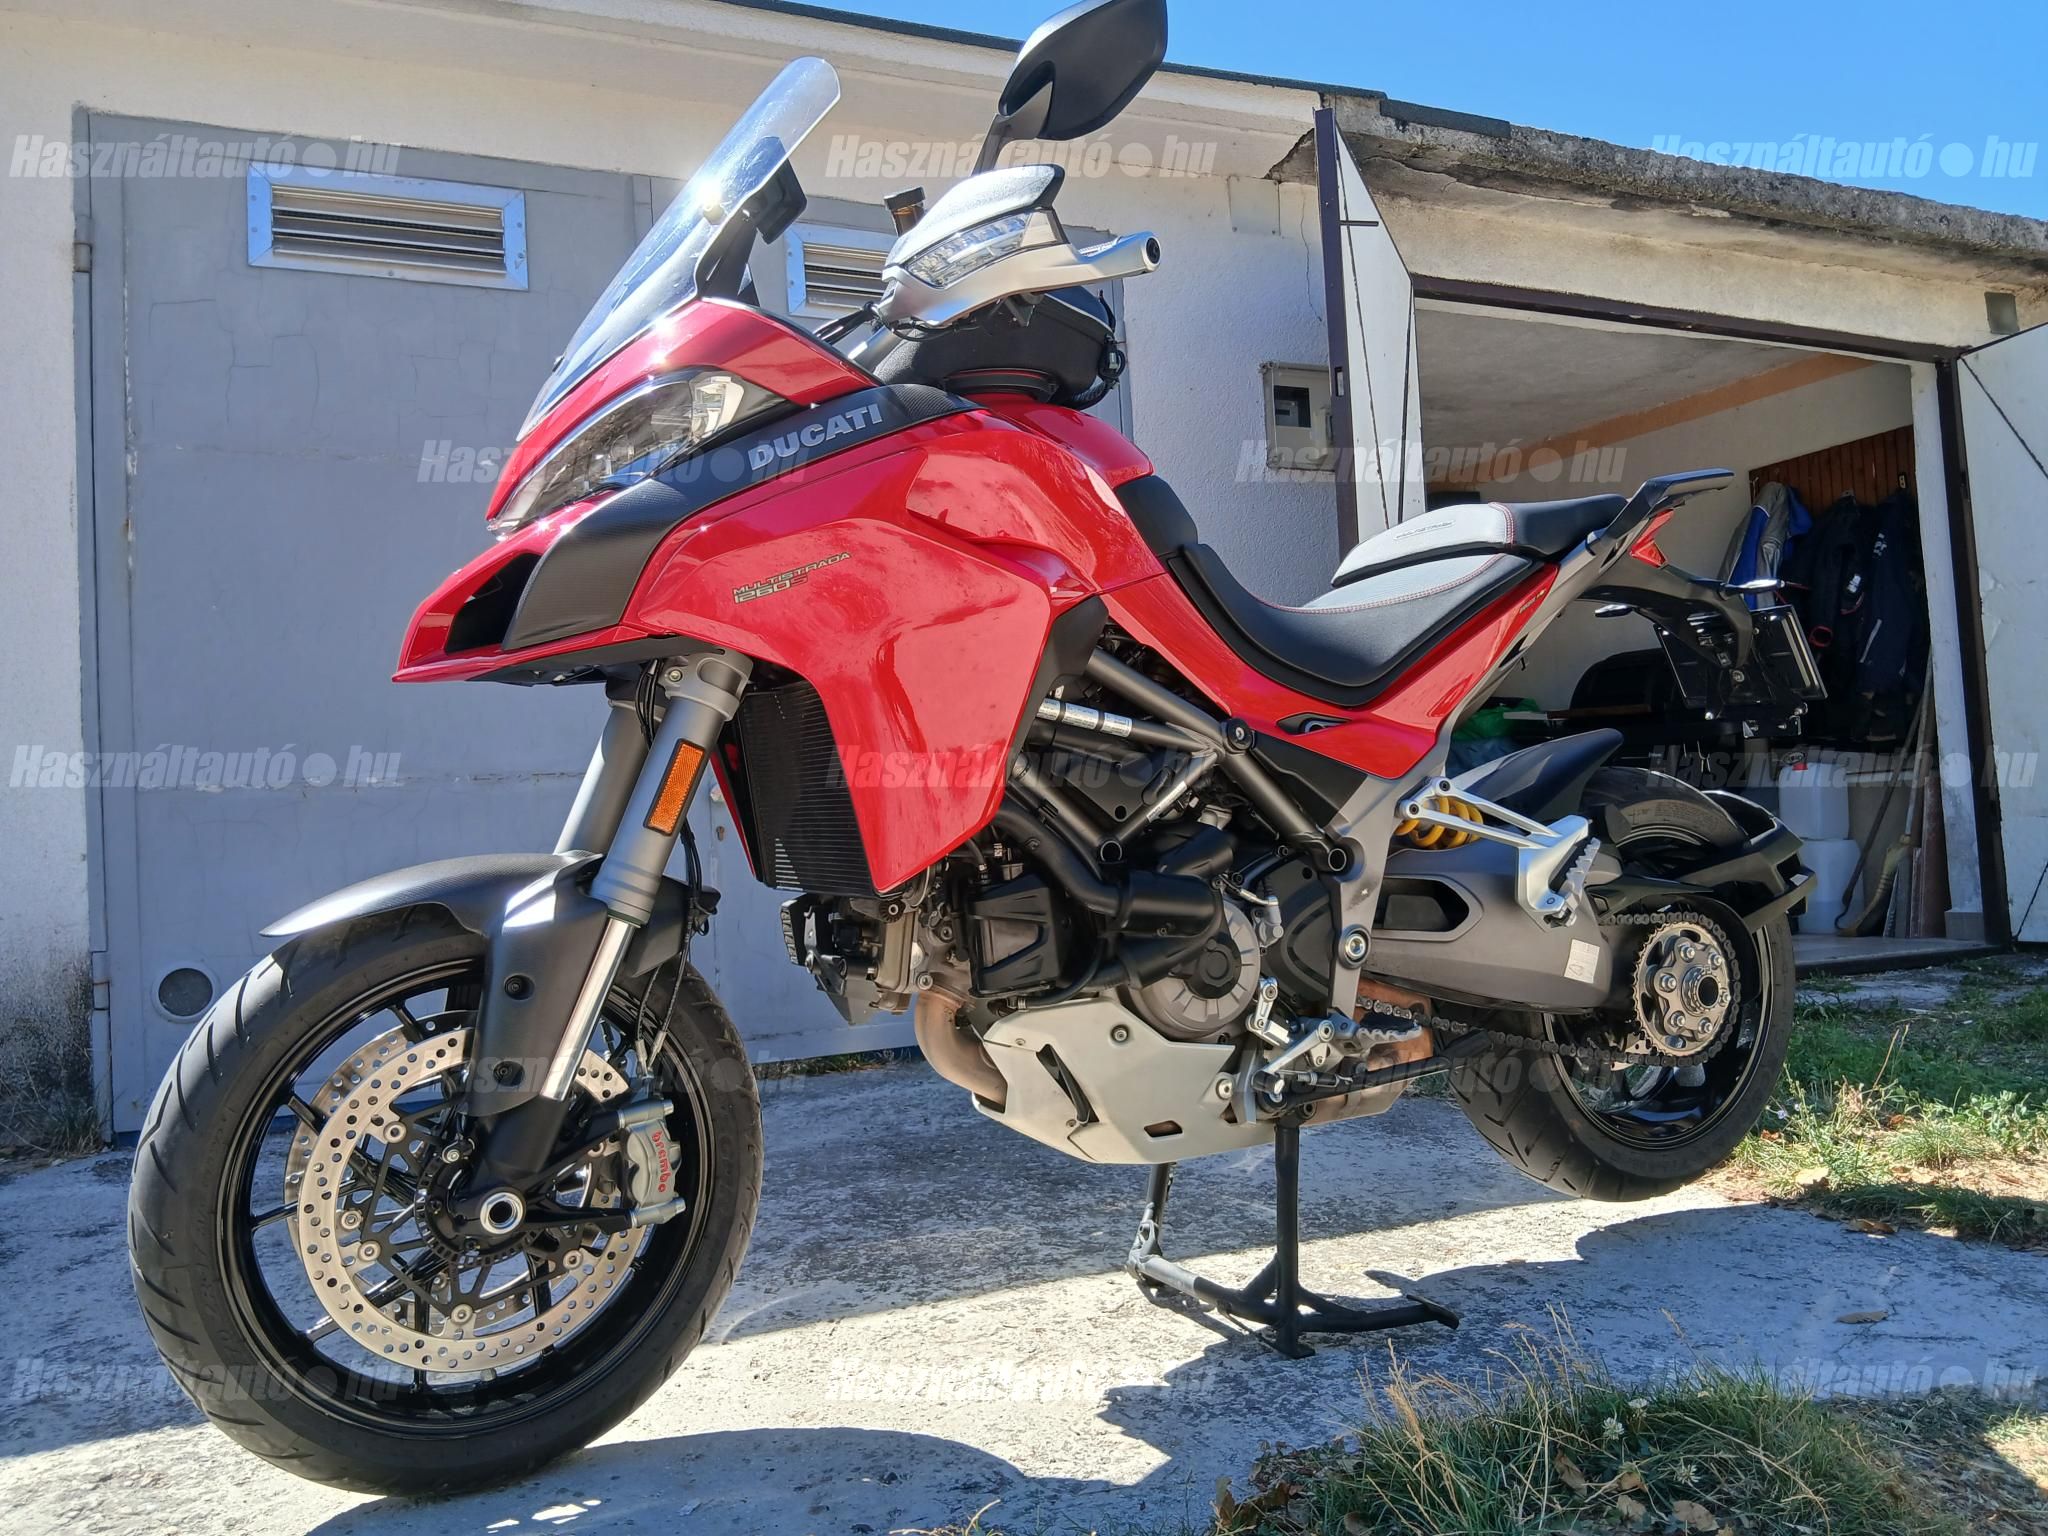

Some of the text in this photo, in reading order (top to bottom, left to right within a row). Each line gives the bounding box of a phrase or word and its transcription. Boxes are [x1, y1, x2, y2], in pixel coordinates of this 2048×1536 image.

[748, 403, 883, 471] DUCATI
[732, 552, 851, 595] MULTISTRADA
[652, 1131, 672, 1192] brembo
